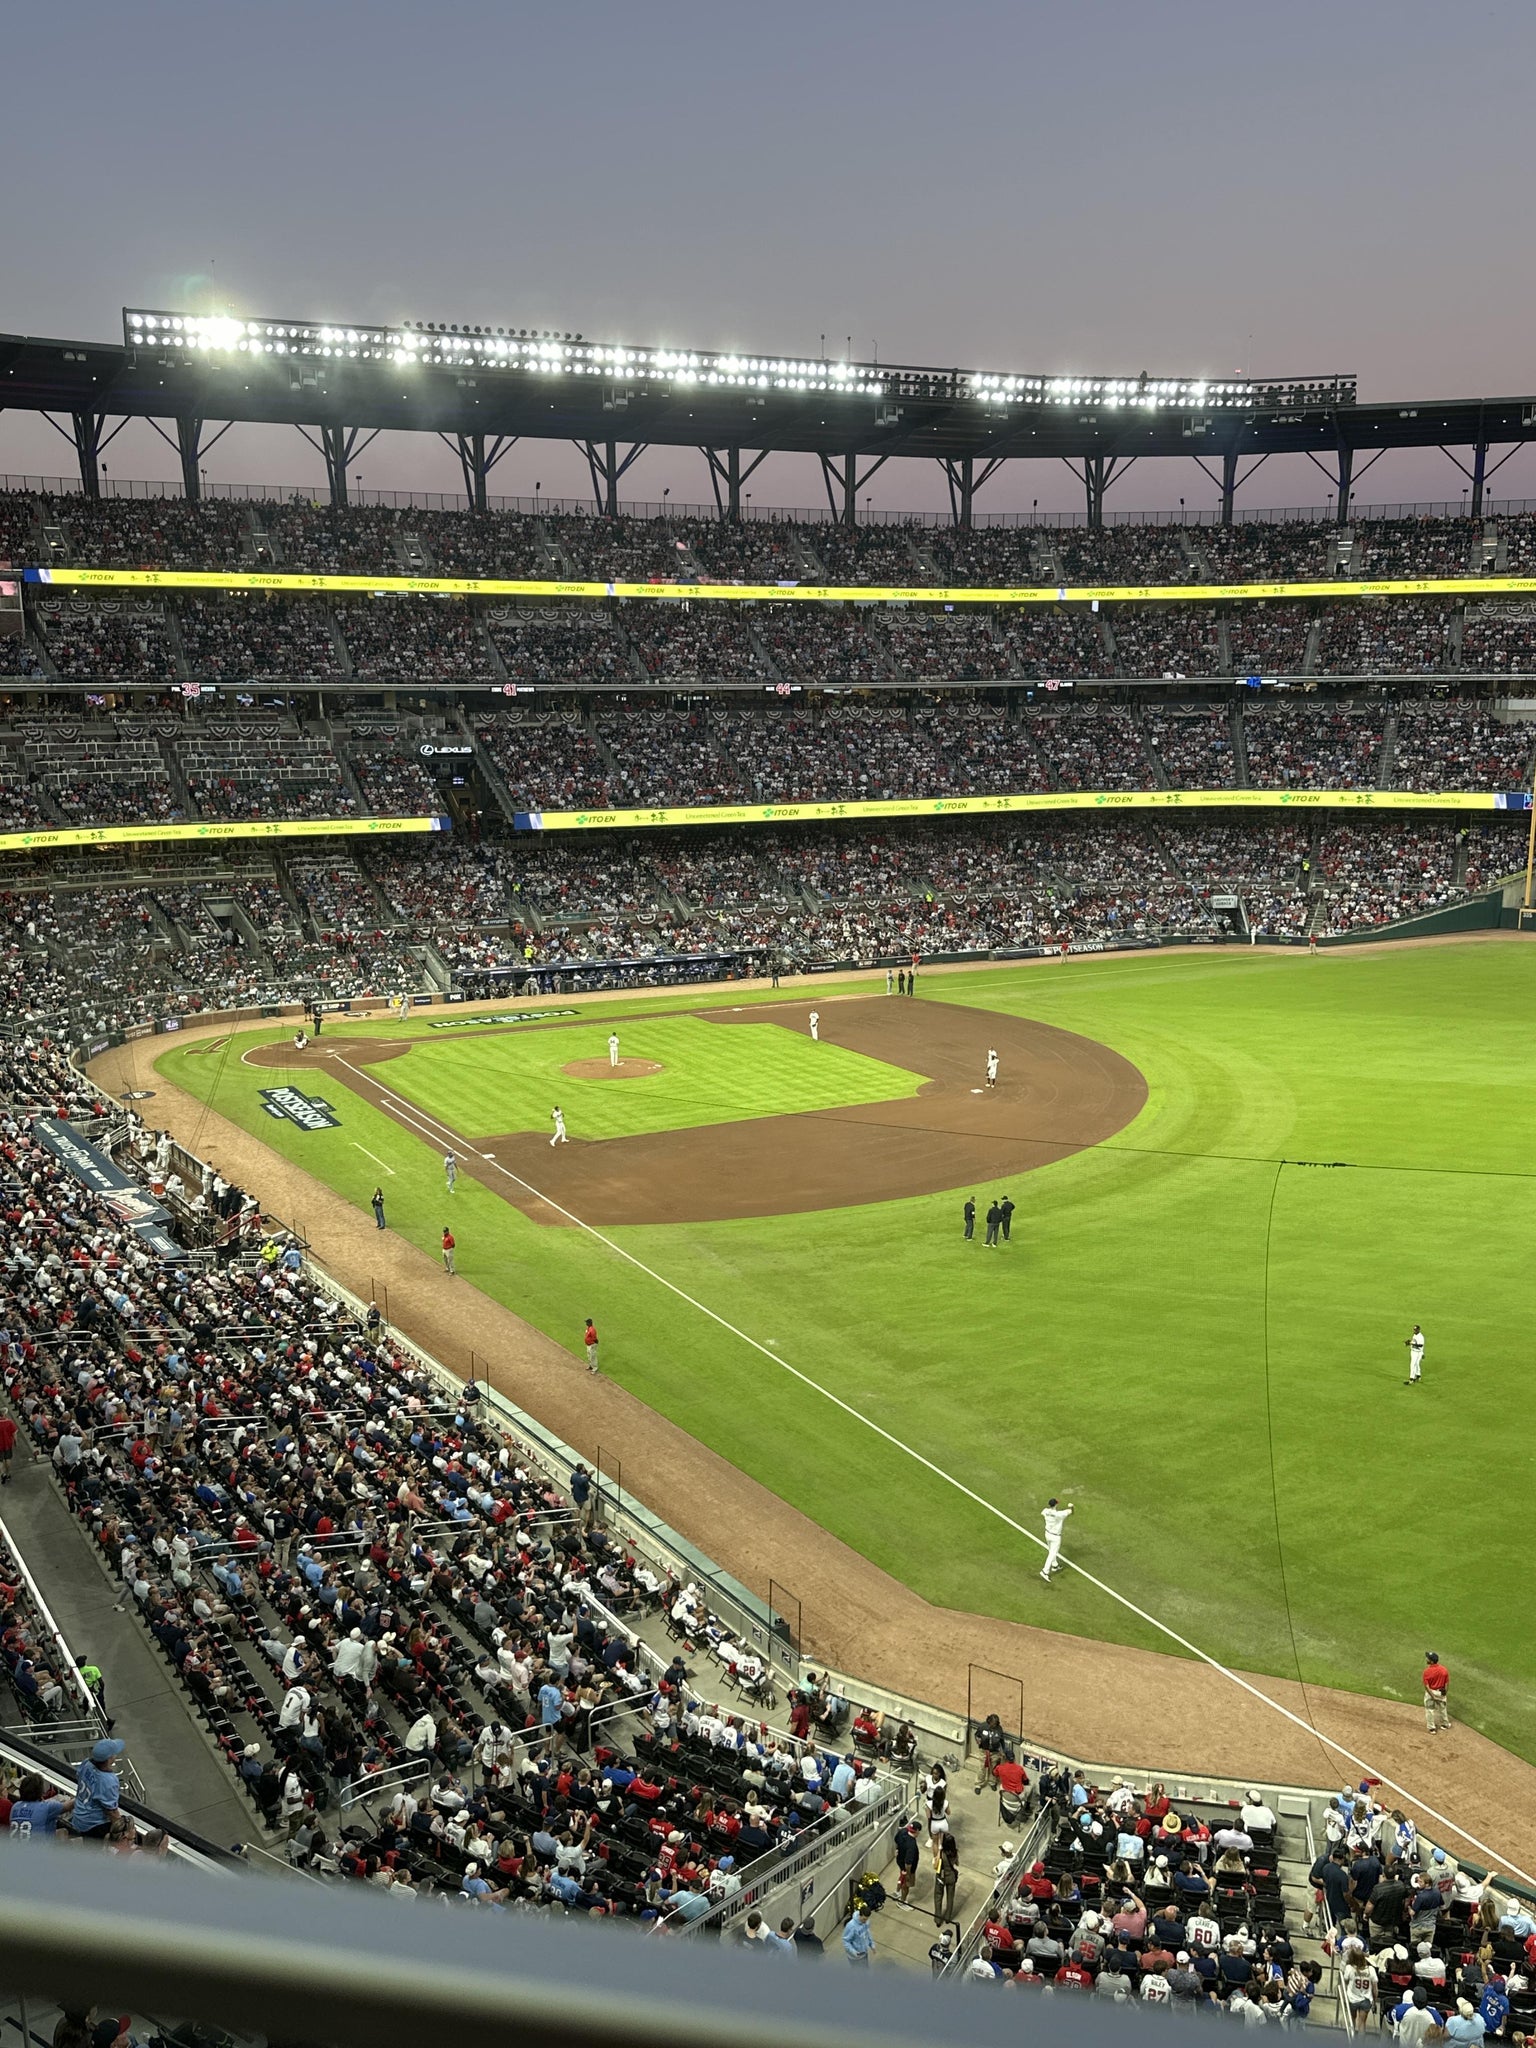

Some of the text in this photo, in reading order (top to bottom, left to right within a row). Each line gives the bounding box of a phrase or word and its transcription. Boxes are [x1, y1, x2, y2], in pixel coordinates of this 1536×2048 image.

[182, 682, 200, 697] 35
[502, 684, 516, 696] 41
[776, 682, 790, 694] 44
[1045, 680, 1060, 690] 47
[266, 1088, 334, 1130] POSTSEASON
[744, 1666, 756, 1676] 28
[286, 1697, 294, 1708] 1
[700, 1726, 711, 1739] 13
[1194, 1928, 1212, 1944] 60
[1080, 1941, 1096, 1960] 25
[1066, 1971, 1082, 1980] OLSON
[1355, 1978, 1370, 1990] 99
[1148, 1988, 1166, 2001] 27
[1486, 2004, 1497, 2017] 13
